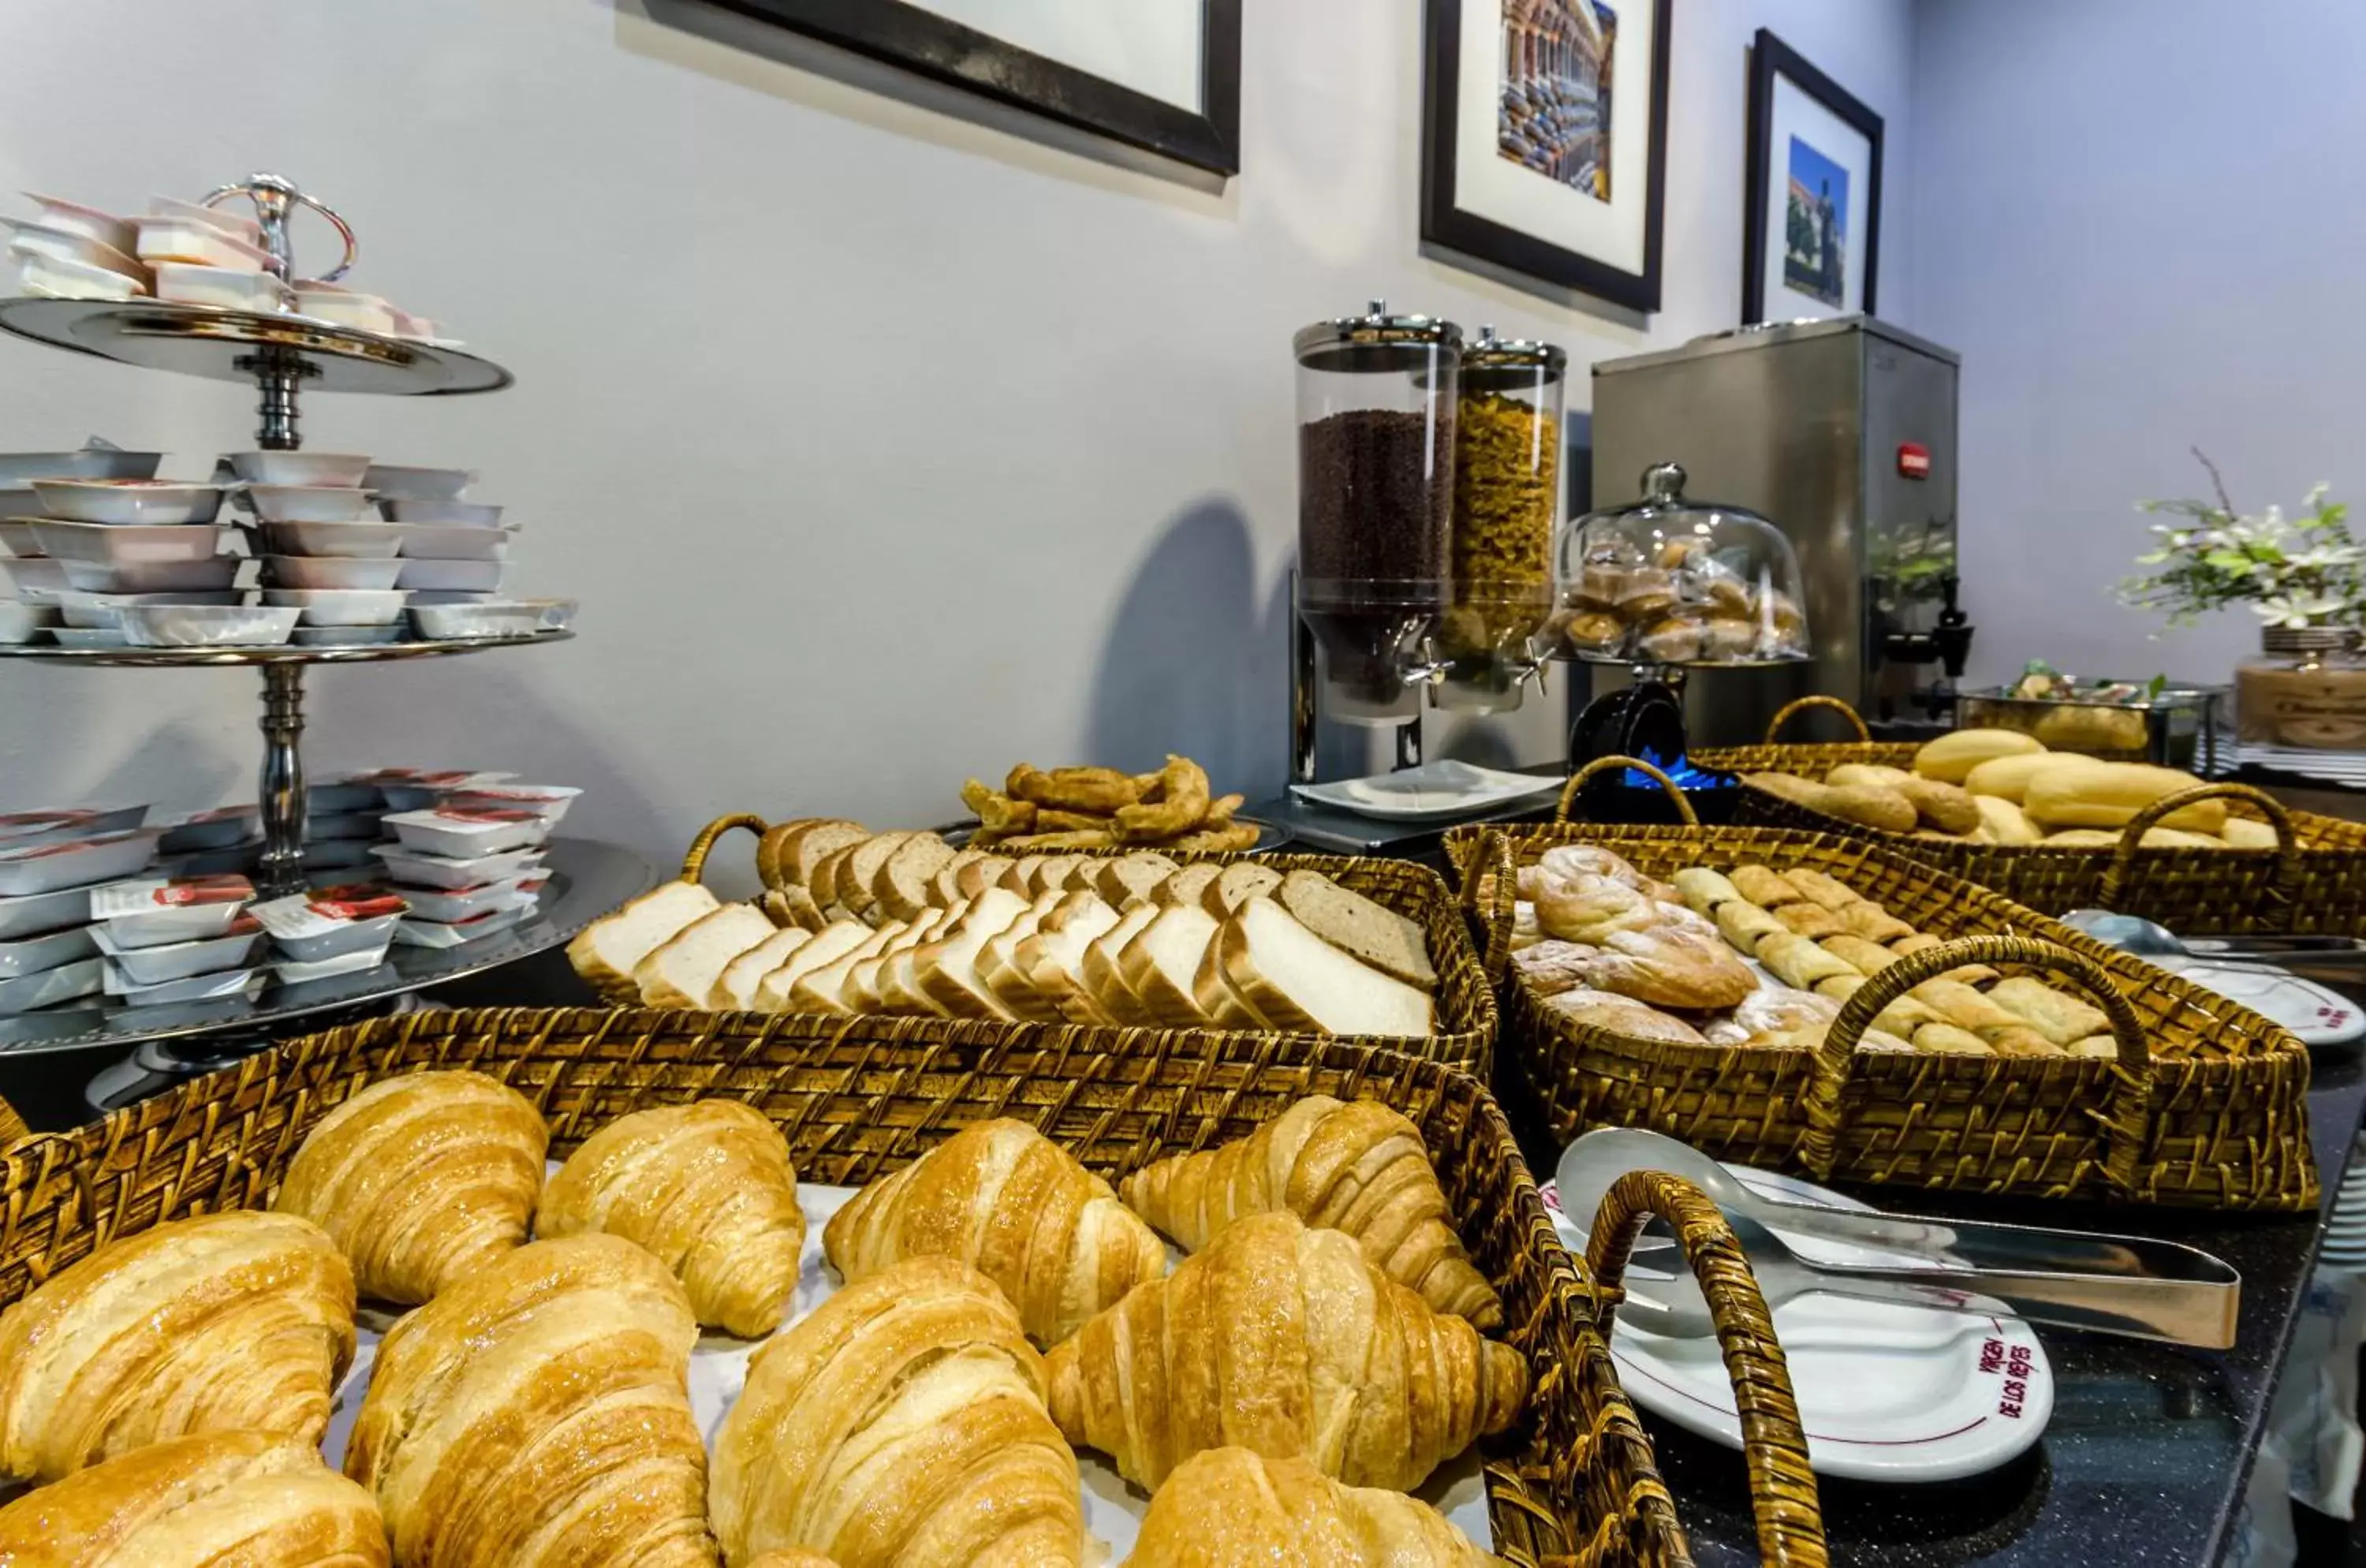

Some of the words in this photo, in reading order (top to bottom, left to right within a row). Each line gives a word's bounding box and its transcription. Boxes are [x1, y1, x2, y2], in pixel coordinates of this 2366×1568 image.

[1979, 1337, 2007, 1374] VIRGEN
[2006, 1345, 2040, 1379] REYES
[2001, 1379, 2026, 1403] LOS
[1998, 1401, 2022, 1419] DE
